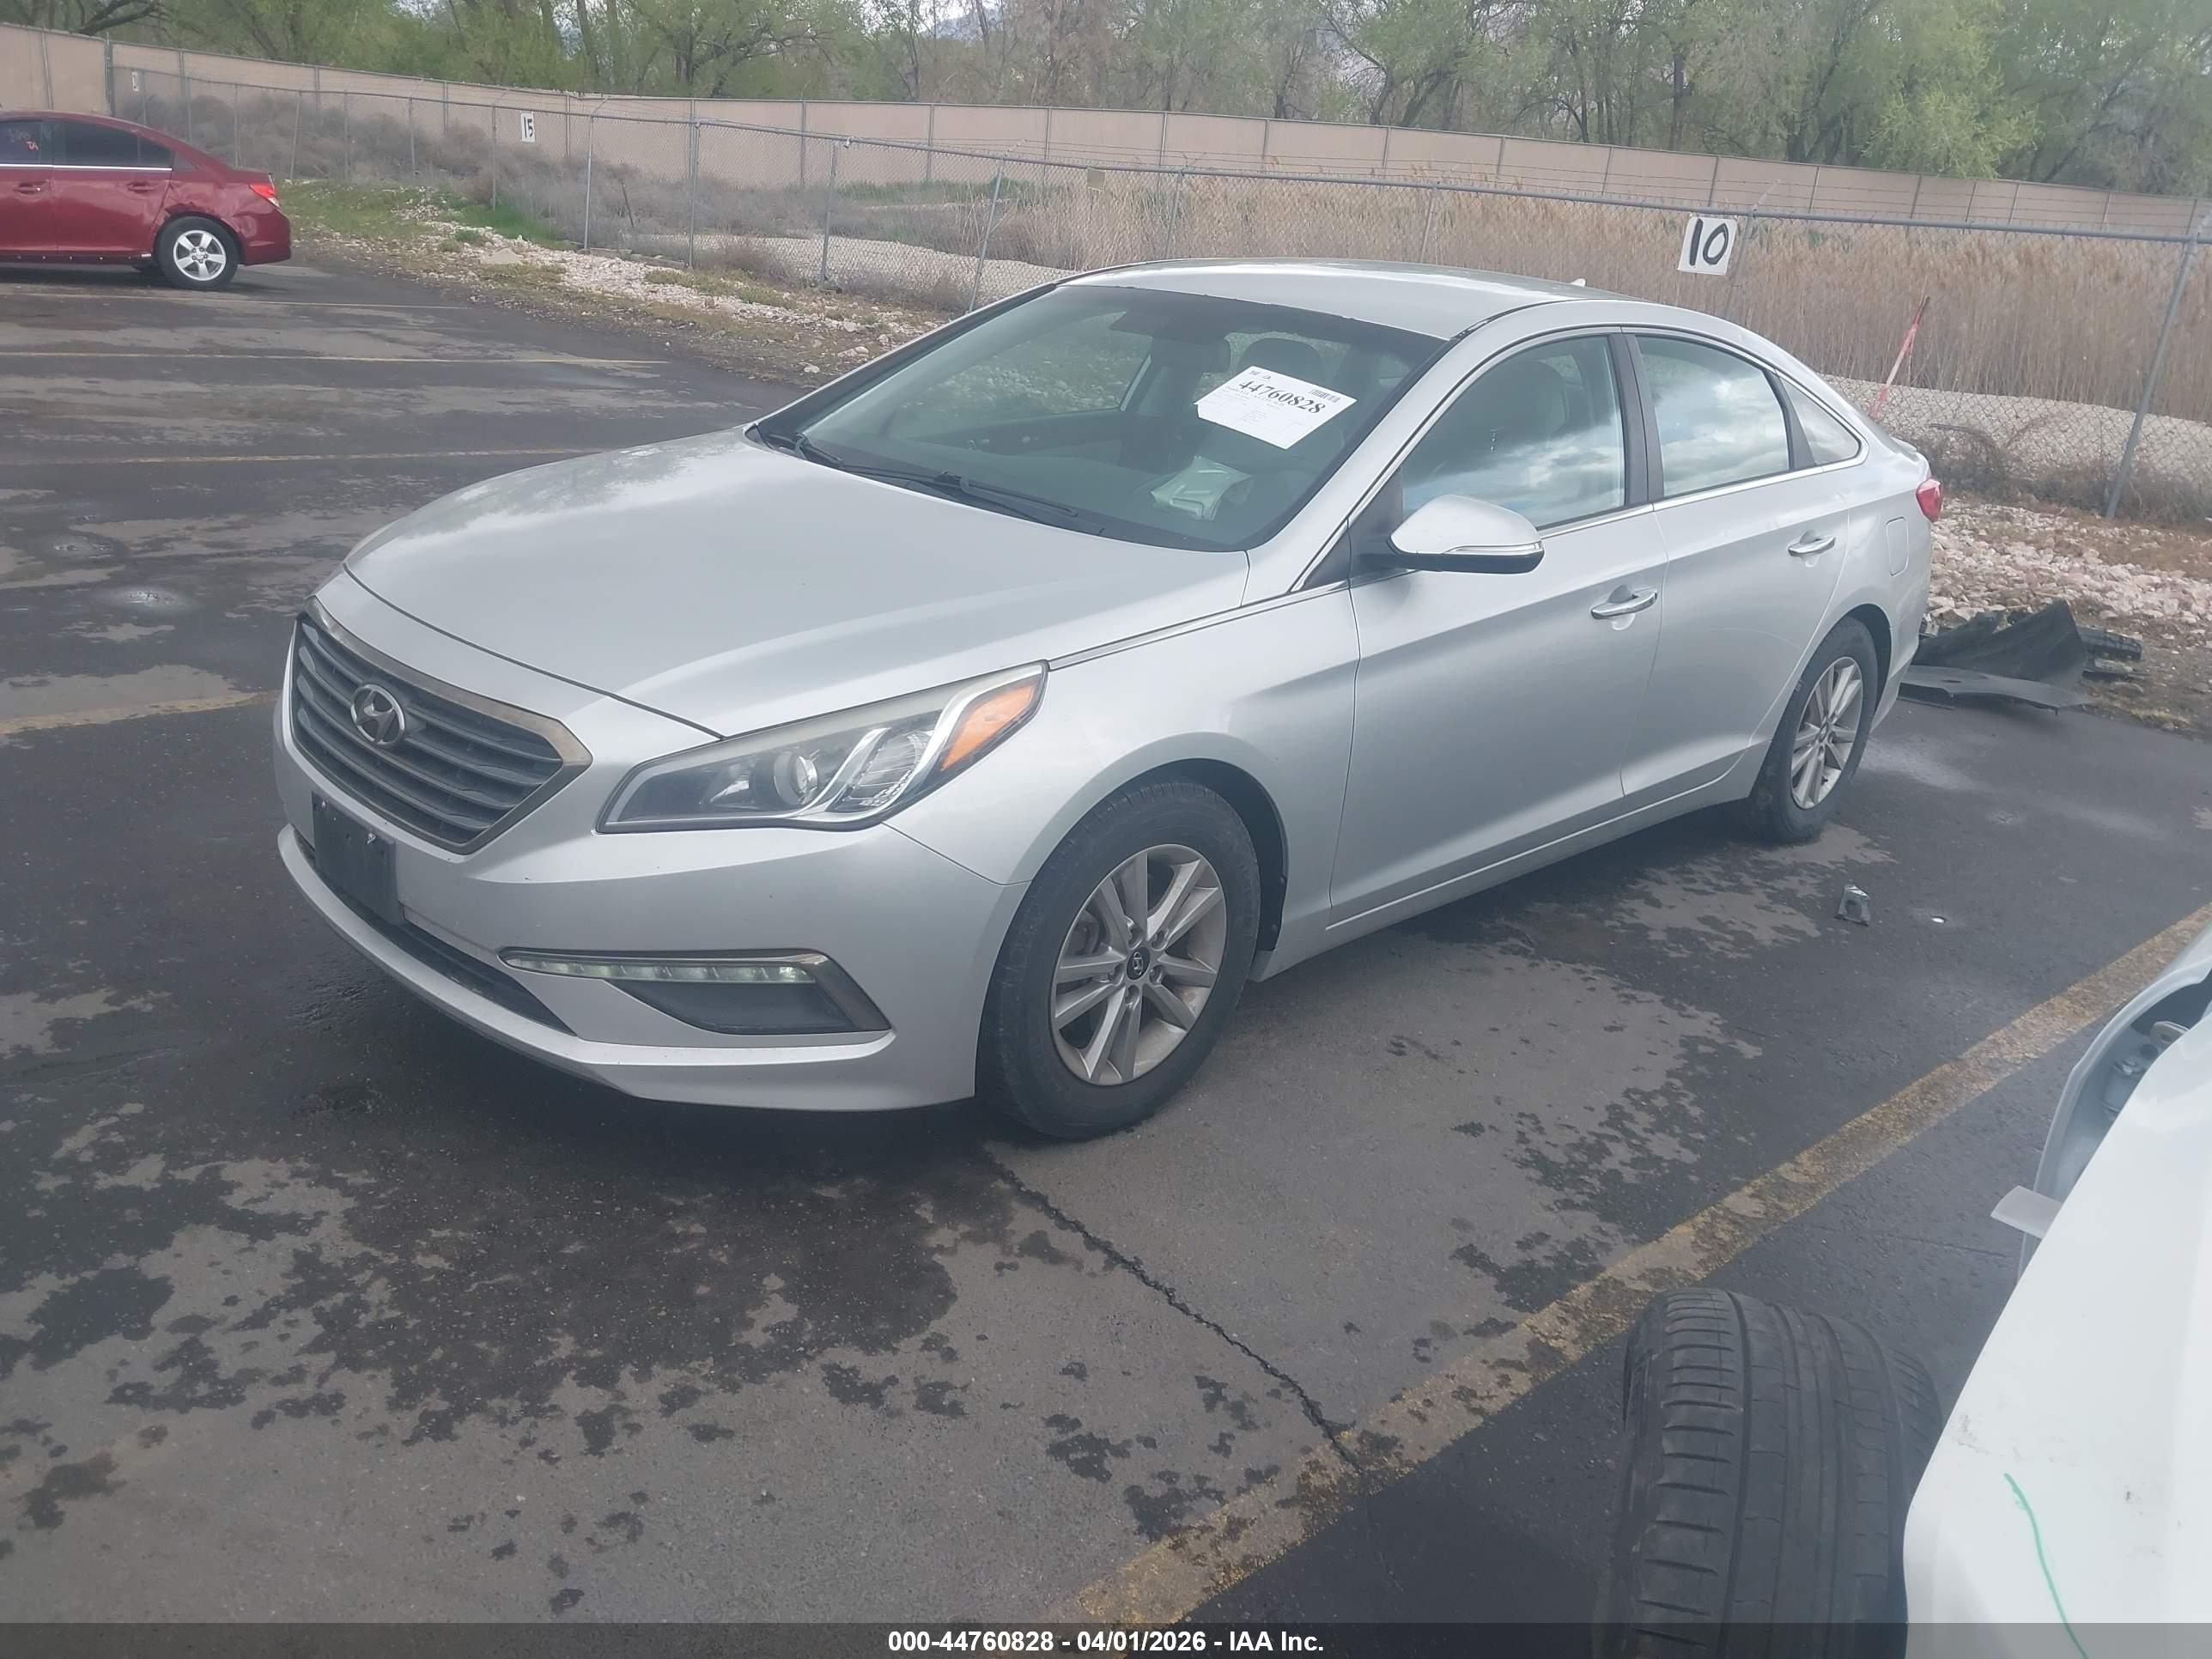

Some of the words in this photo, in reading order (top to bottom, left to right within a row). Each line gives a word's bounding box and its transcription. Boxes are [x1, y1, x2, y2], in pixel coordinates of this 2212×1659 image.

[524, 116, 533, 138] 15
[1689, 218, 1729, 265] 10
[1239, 380, 1326, 414] 44760828
